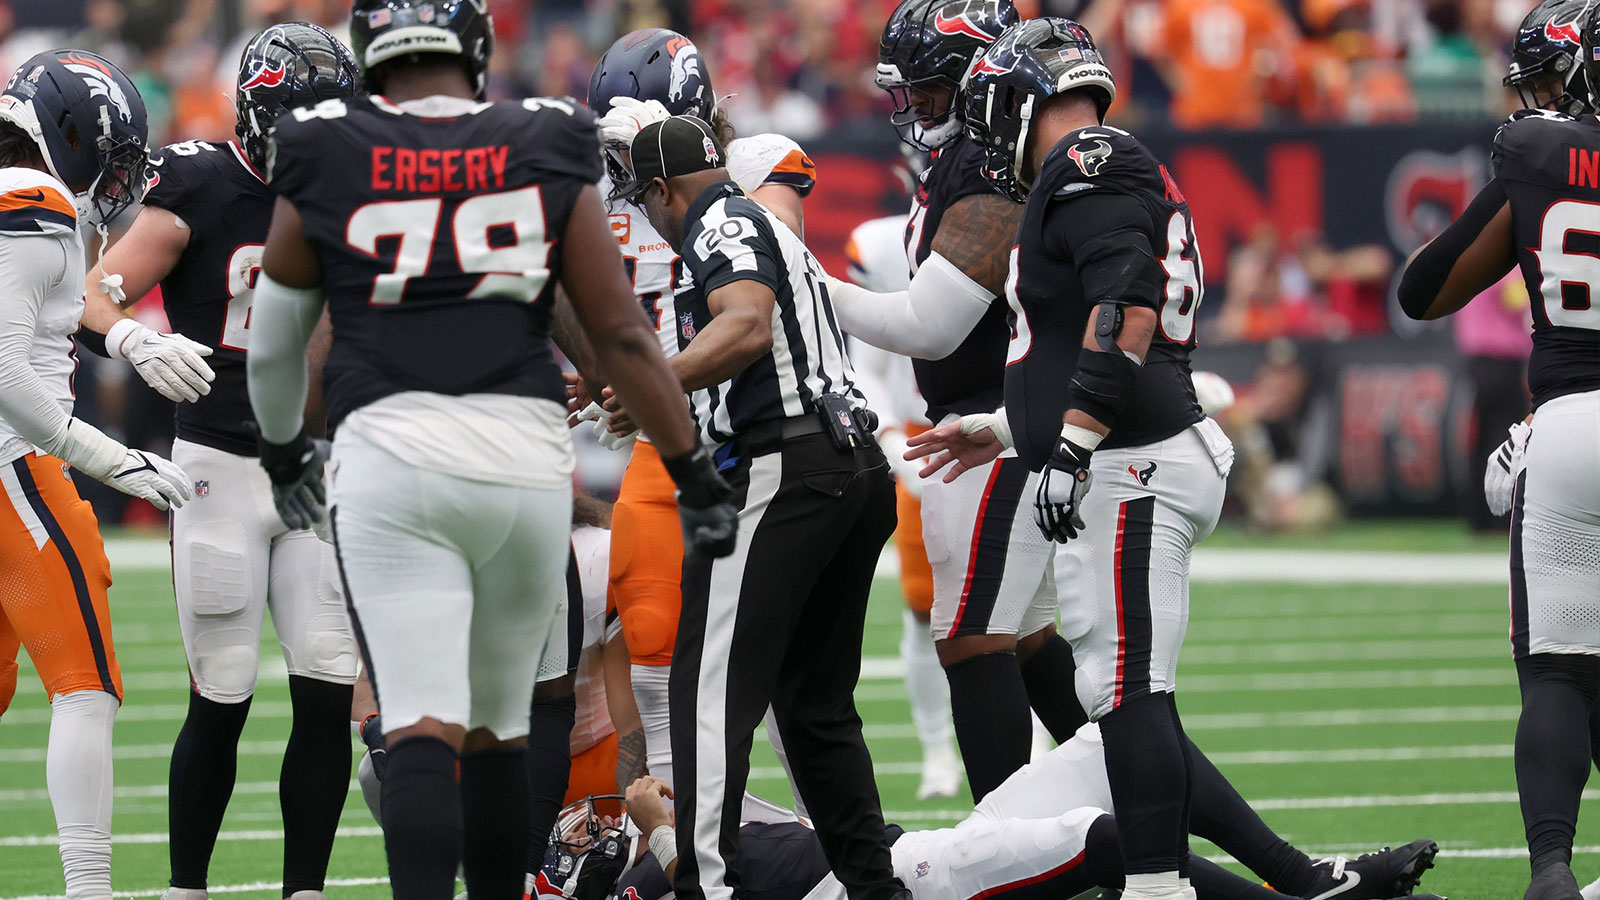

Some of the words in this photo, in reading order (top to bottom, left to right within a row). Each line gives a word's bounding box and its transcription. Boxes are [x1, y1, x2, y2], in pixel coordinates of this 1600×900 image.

[373, 36, 447, 53] HOUSTON
[371, 145, 509, 192] ERSERY
[1568, 147, 1600, 189] IN
[344, 184, 558, 305] 79
[701, 220, 743, 251] 20
